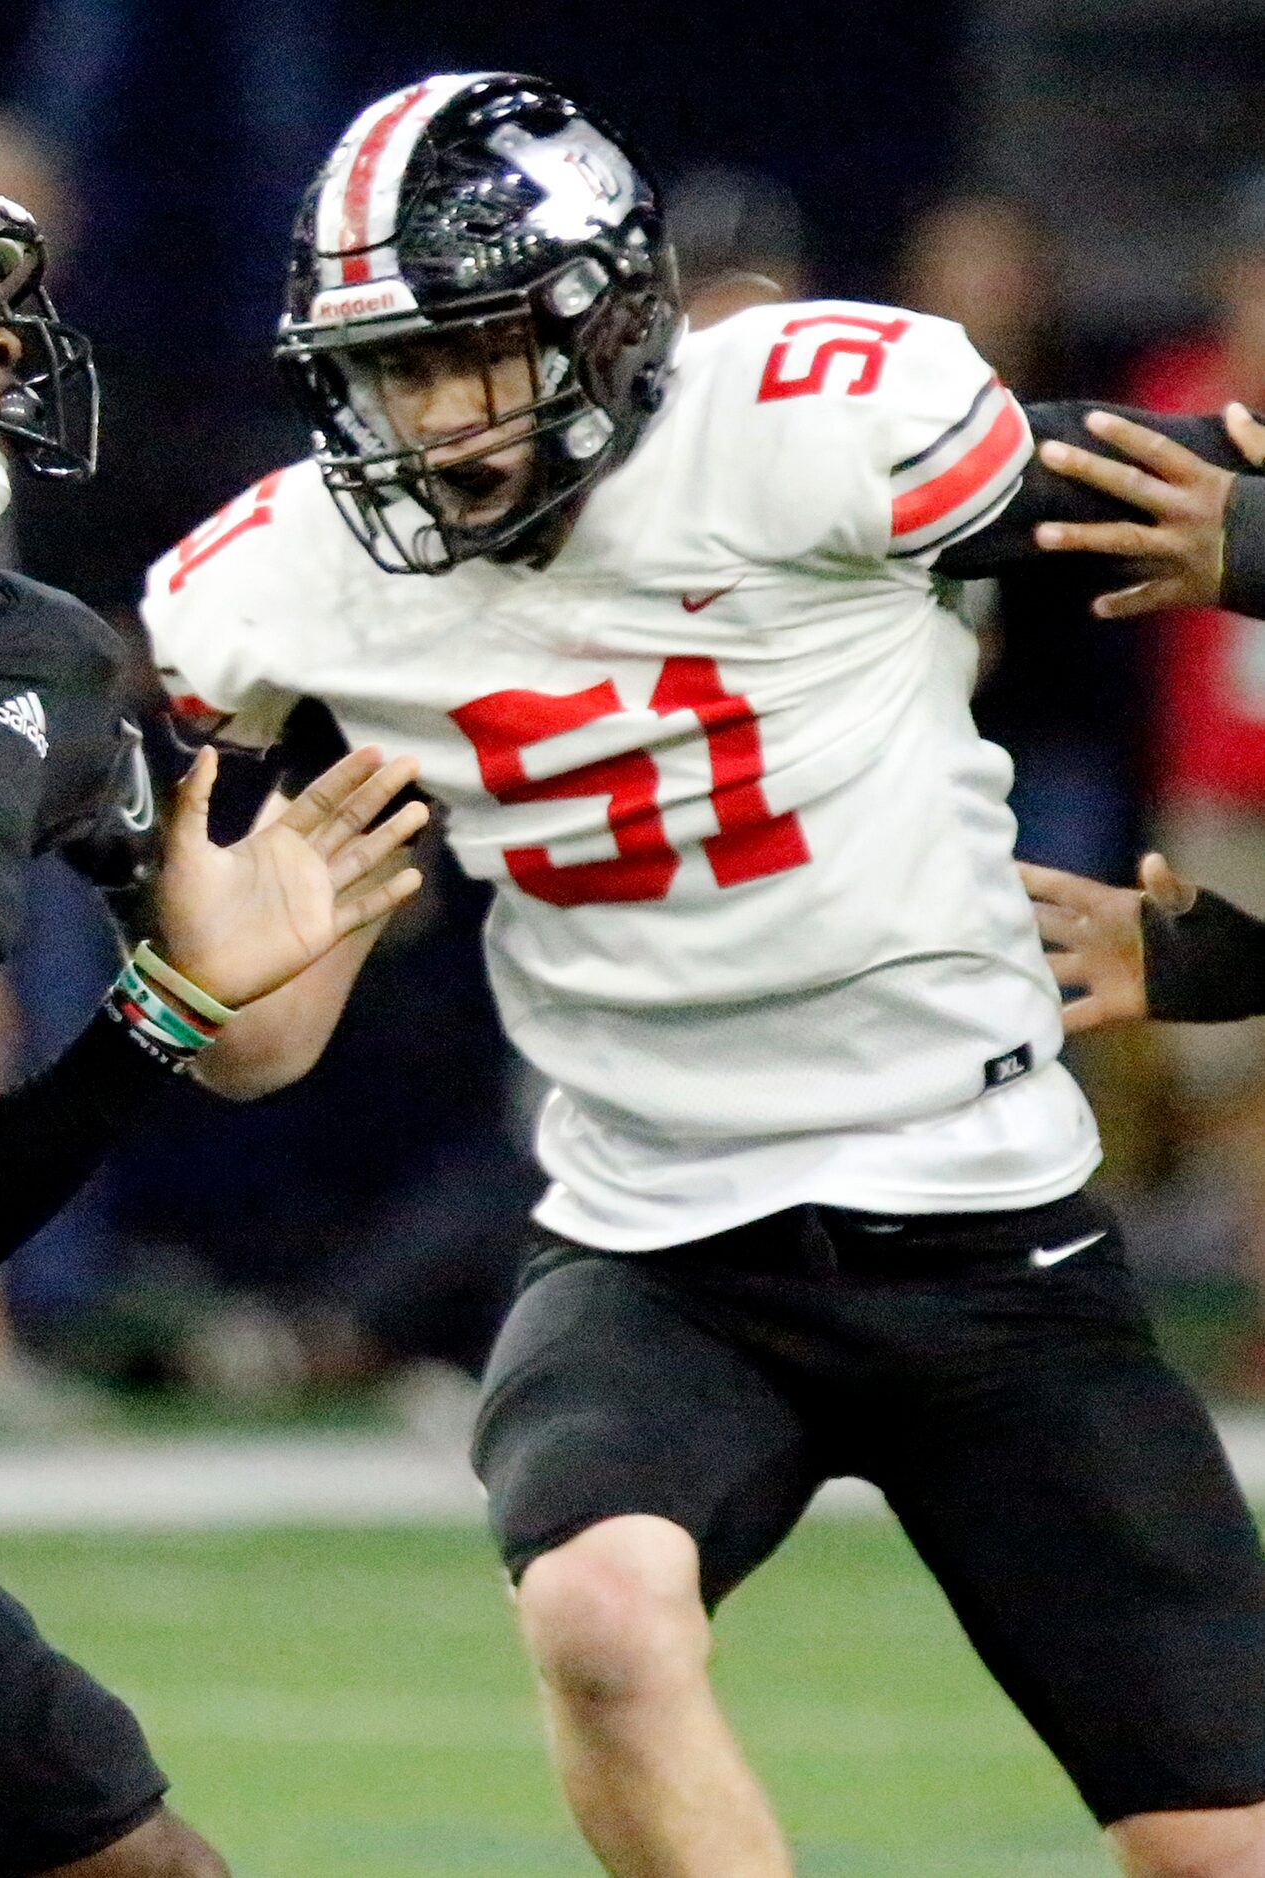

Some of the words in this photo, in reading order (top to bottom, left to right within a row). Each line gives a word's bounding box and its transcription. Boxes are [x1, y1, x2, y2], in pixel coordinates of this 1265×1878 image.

[320, 293, 395, 317] Riddell
[756, 314, 913, 404] 51
[448, 655, 812, 908] 51
